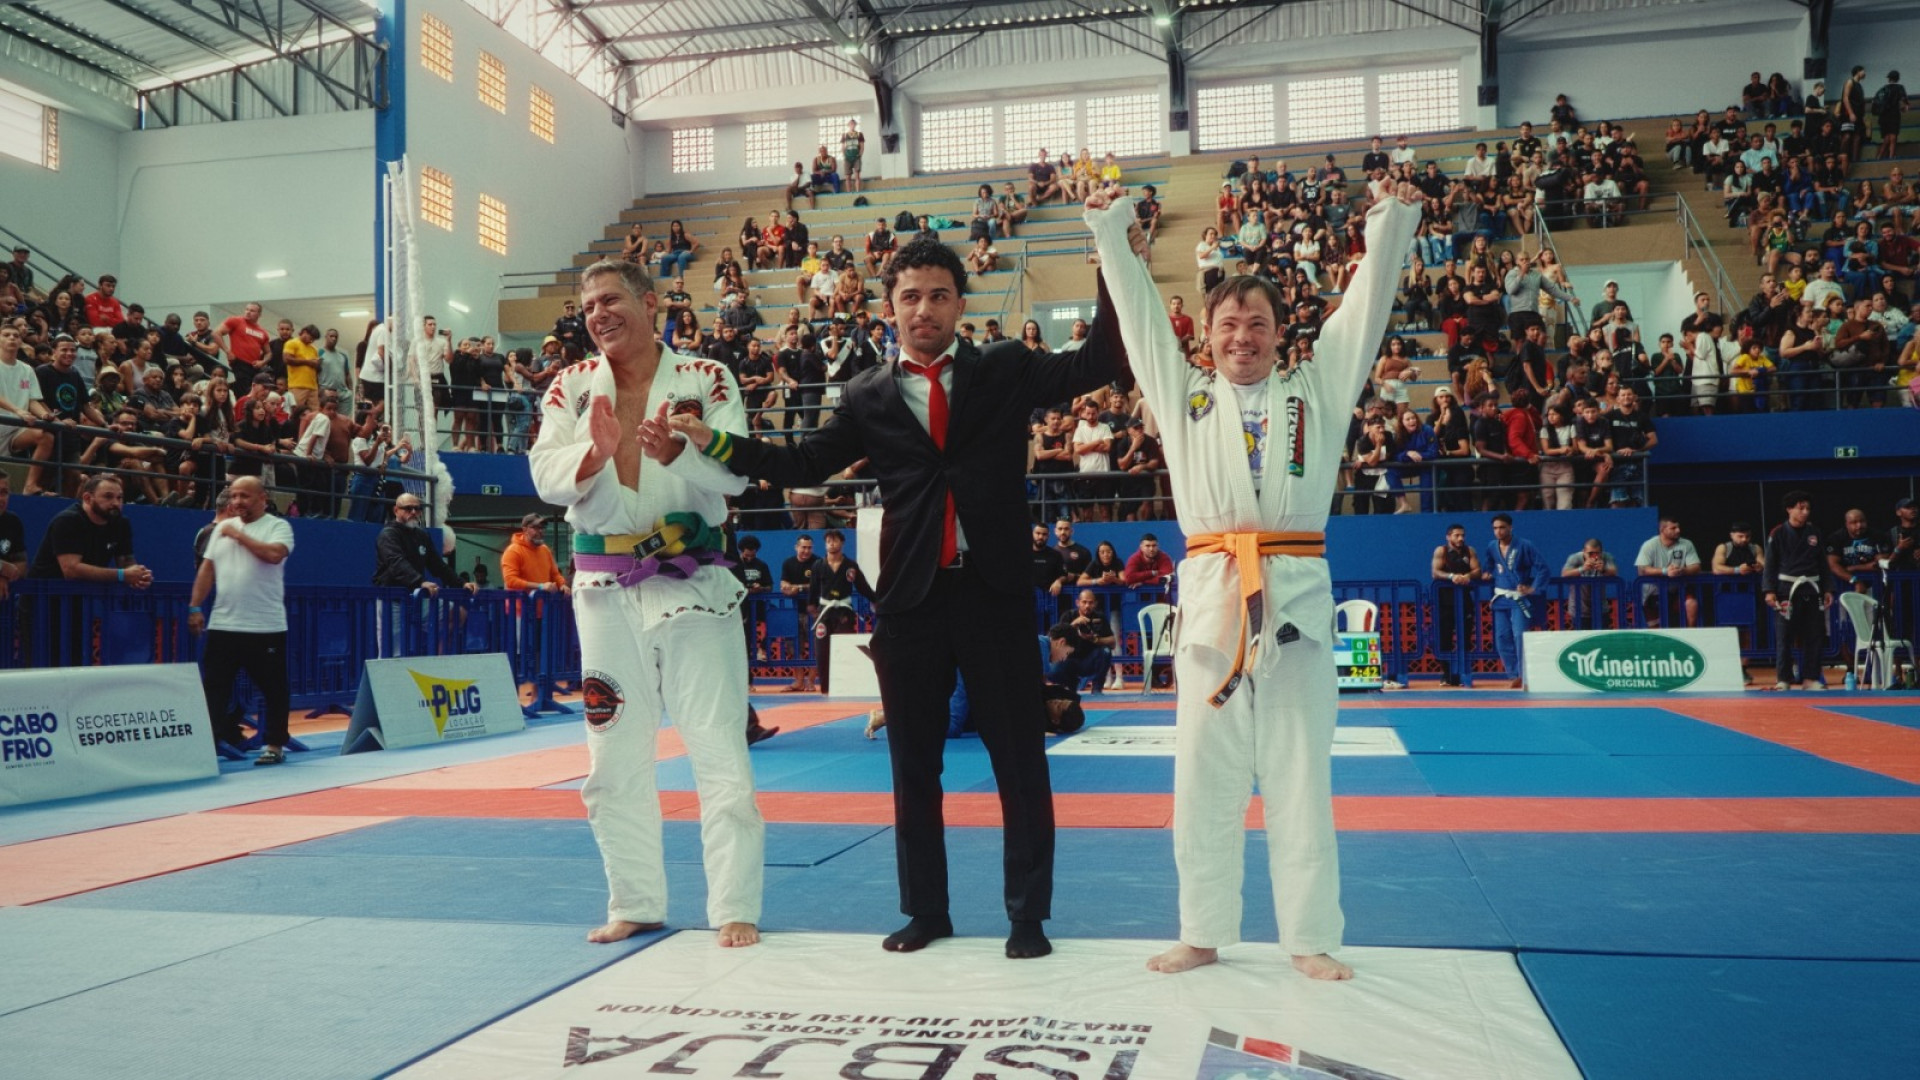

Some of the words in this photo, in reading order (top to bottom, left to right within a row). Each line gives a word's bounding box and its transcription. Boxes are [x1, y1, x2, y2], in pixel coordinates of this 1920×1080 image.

[1350, 666, 1378, 677] 2:42
[1606, 678, 1659, 688] ORIGINAL
[431, 684, 481, 717] PLUG
[0, 711, 58, 736] CABO
[76, 711, 158, 730] SECRETARIA
[160, 709, 177, 722] DE
[78, 729, 141, 747] ESPORTE
[143, 727, 151, 740] E
[153, 723, 193, 739] LAZER
[3, 737, 53, 762] FRIO
[596, 1004, 802, 1022] ASSOCIATION
[807, 1013, 960, 1028] JIU-JITSU
[741, 1022, 866, 1036] SPORTS
[968, 1015, 1153, 1033] BRAZILIAN
[879, 1027, 1147, 1045] INTERNATIONAL
